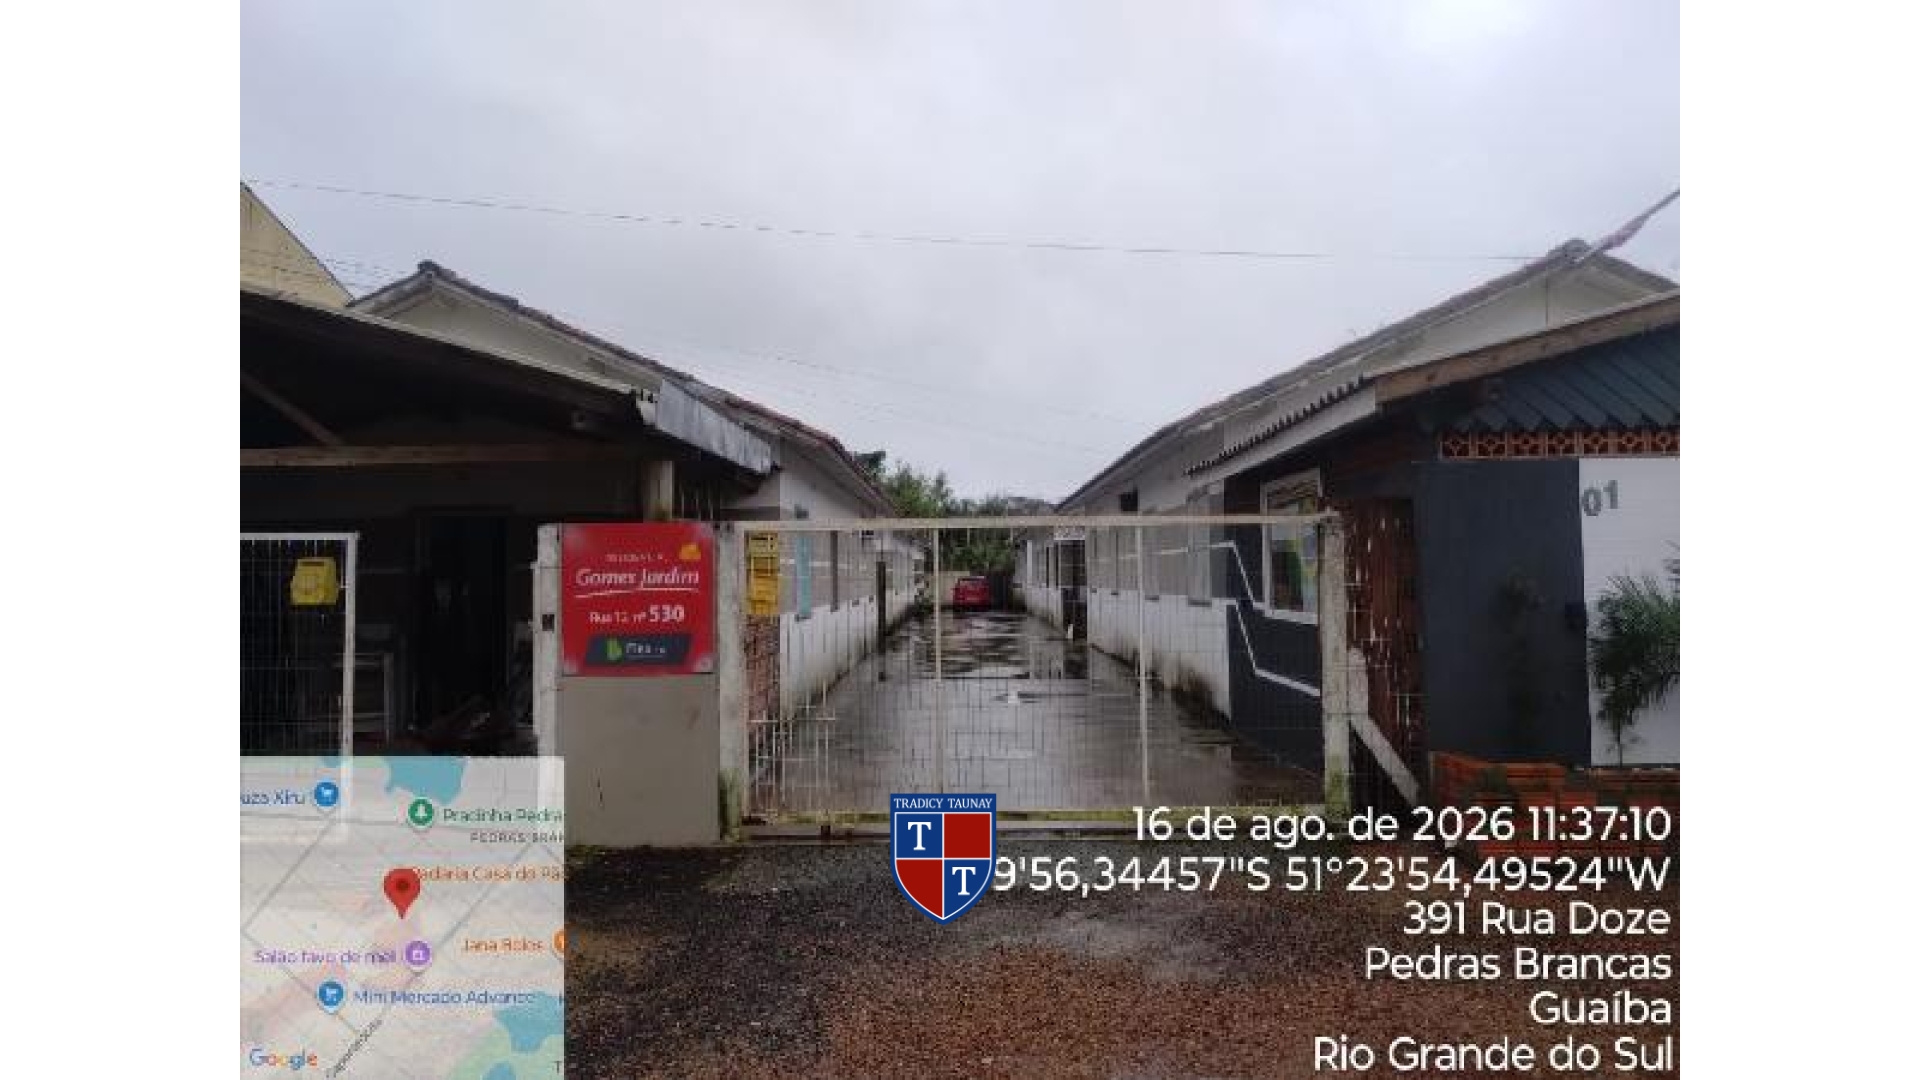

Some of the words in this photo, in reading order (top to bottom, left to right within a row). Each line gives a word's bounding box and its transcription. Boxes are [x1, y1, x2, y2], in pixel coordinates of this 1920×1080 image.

[1582, 479, 1618, 516] 01
[575, 568, 636, 586] Gomes
[649, 605, 685, 623] 530
